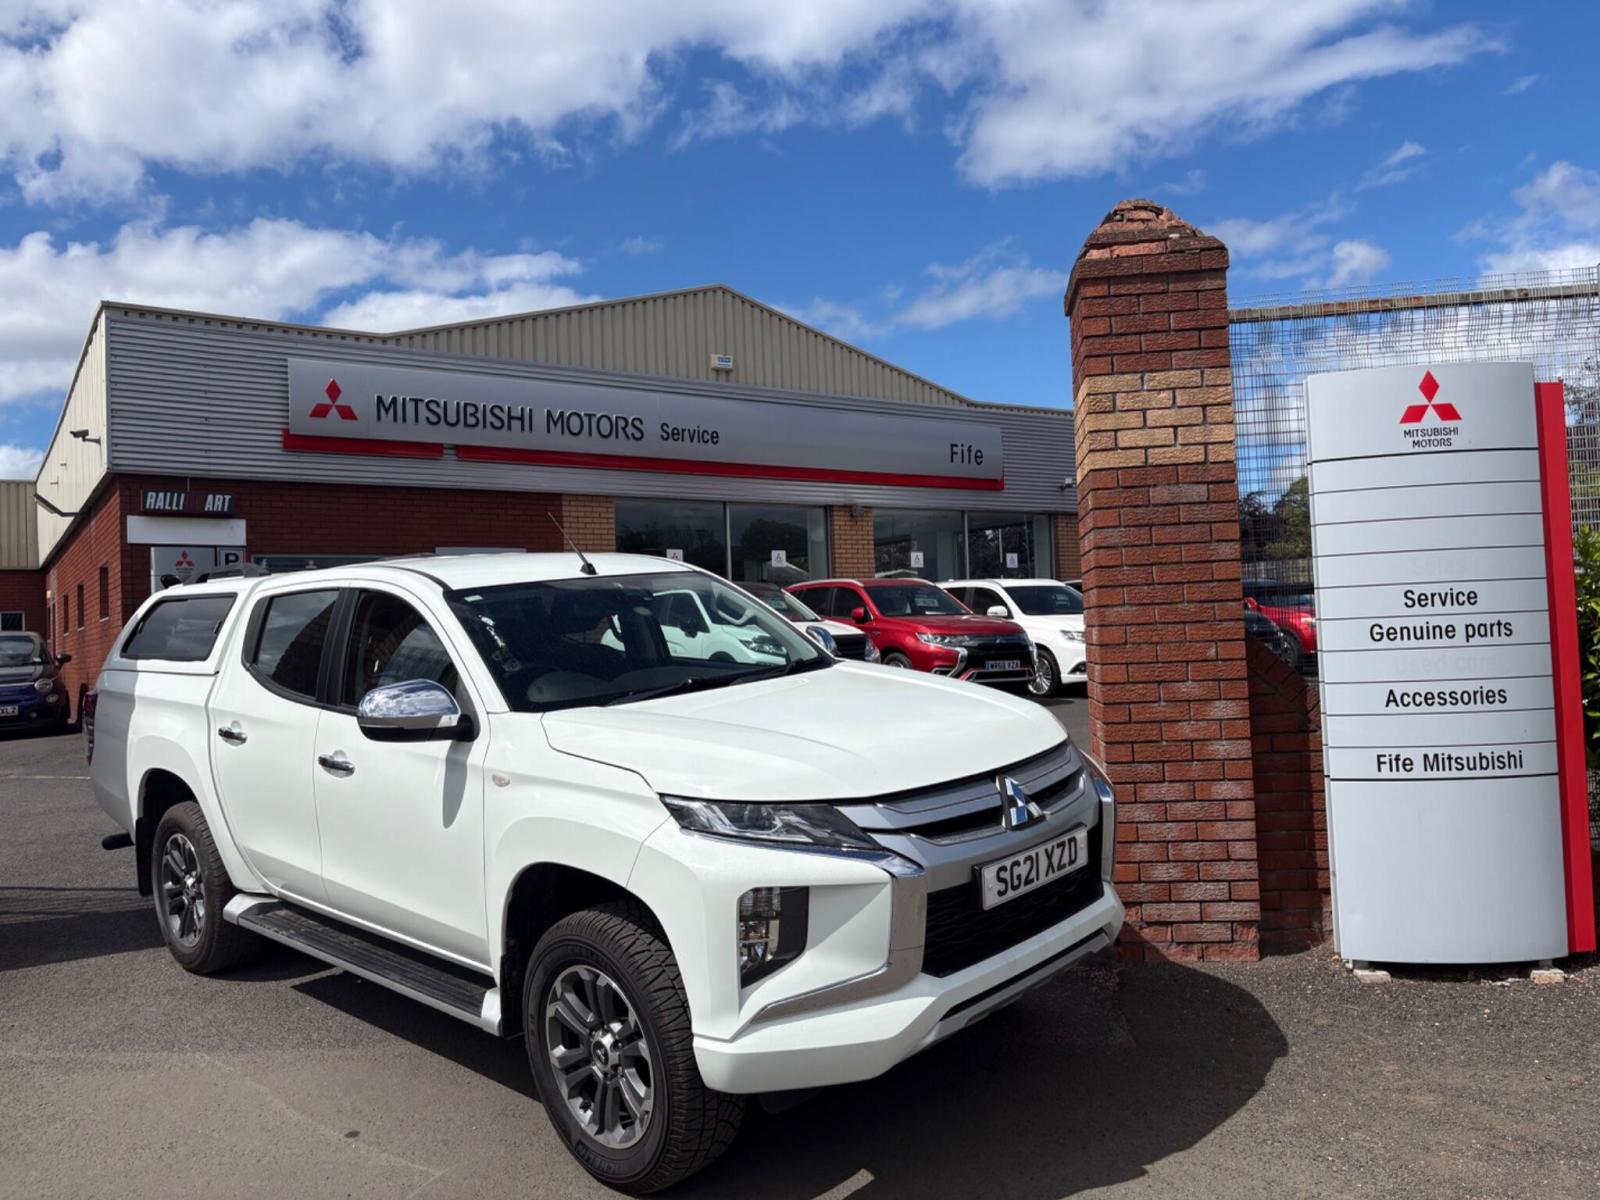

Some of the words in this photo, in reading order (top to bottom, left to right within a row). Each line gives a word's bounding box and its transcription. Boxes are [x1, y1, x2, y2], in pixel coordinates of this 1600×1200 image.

[375, 394, 533, 433] MITSUBISHI
[545, 408, 645, 441] MOTORS
[660, 422, 719, 445] Service
[1403, 426, 1459, 438] MITSUBISHI
[1412, 438, 1452, 448] MOTORS
[950, 443, 984, 466] Fife
[145, 491, 185, 511] RALLI
[204, 493, 231, 512] ART
[1403, 587, 1478, 609] Service
[1369, 620, 1457, 643] Genuine
[1464, 619, 1513, 643] parts
[1385, 686, 1508, 708] Accessories
[1376, 754, 1414, 773] Fife
[1423, 750, 1524, 772] Mitsubishi
[996, 852, 1039, 897] SG21
[1045, 836, 1078, 877] XZD
